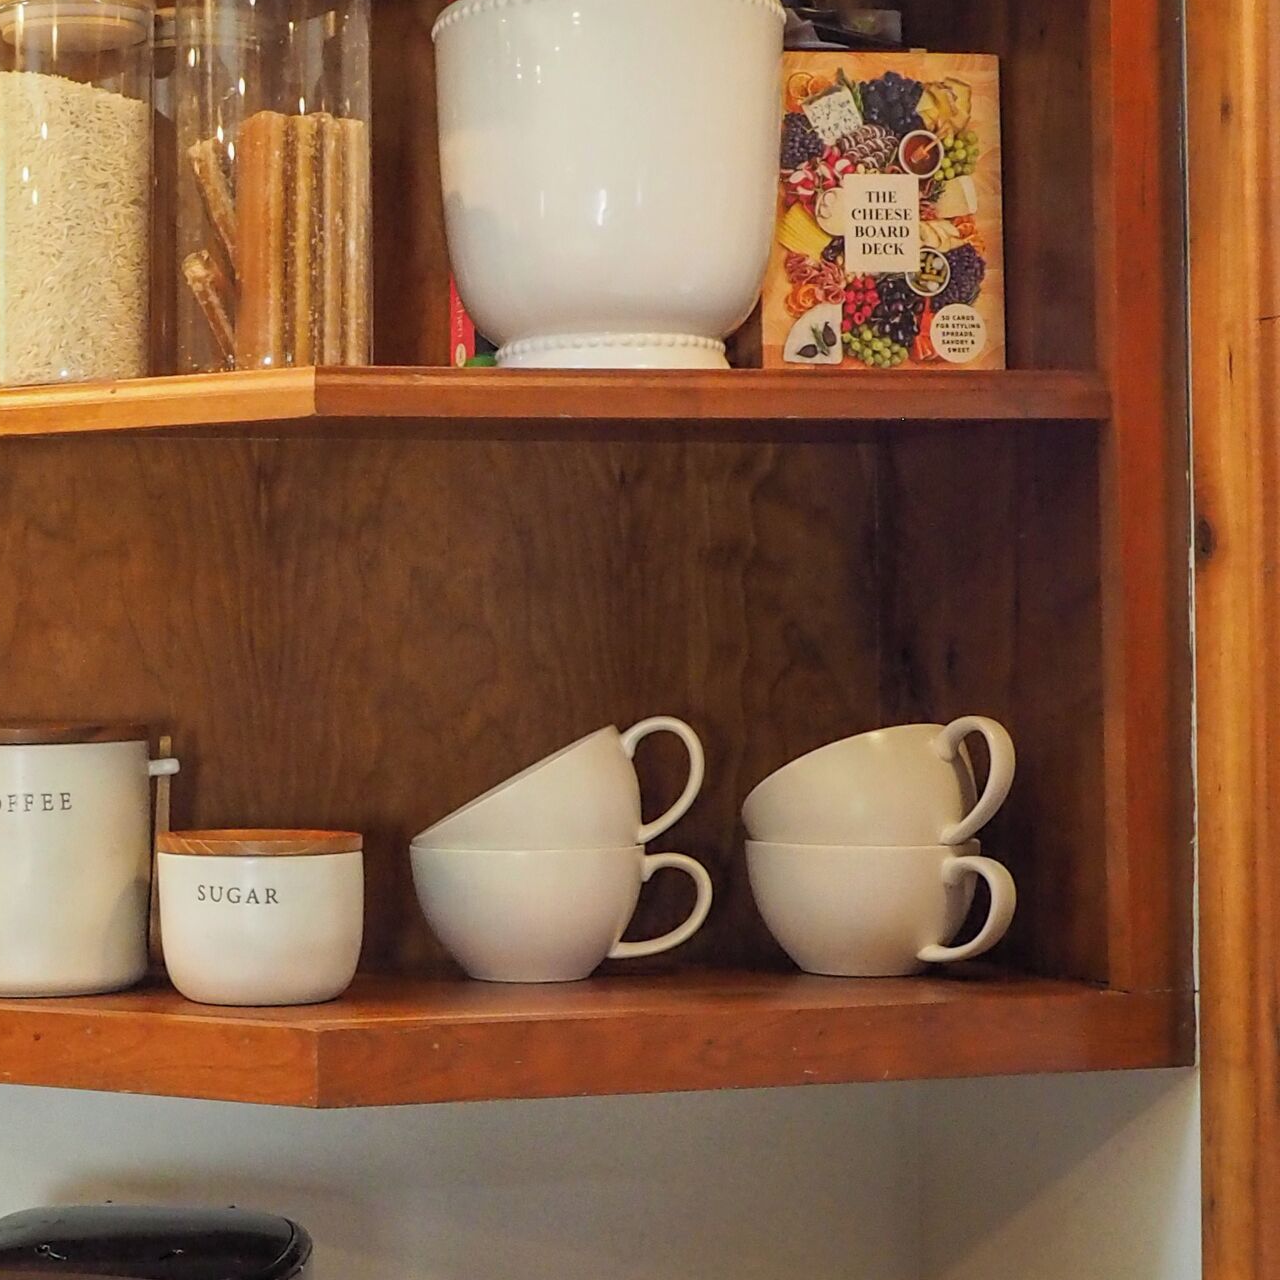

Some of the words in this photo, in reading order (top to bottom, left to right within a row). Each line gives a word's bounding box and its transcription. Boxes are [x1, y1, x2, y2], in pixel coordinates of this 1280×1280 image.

[865, 191, 897, 203] THE
[851, 208, 913, 221] CHEESE
[855, 225, 910, 238] BOARD
[862, 242, 905, 255] DECK
[197, 884, 280, 906] SUGAR
